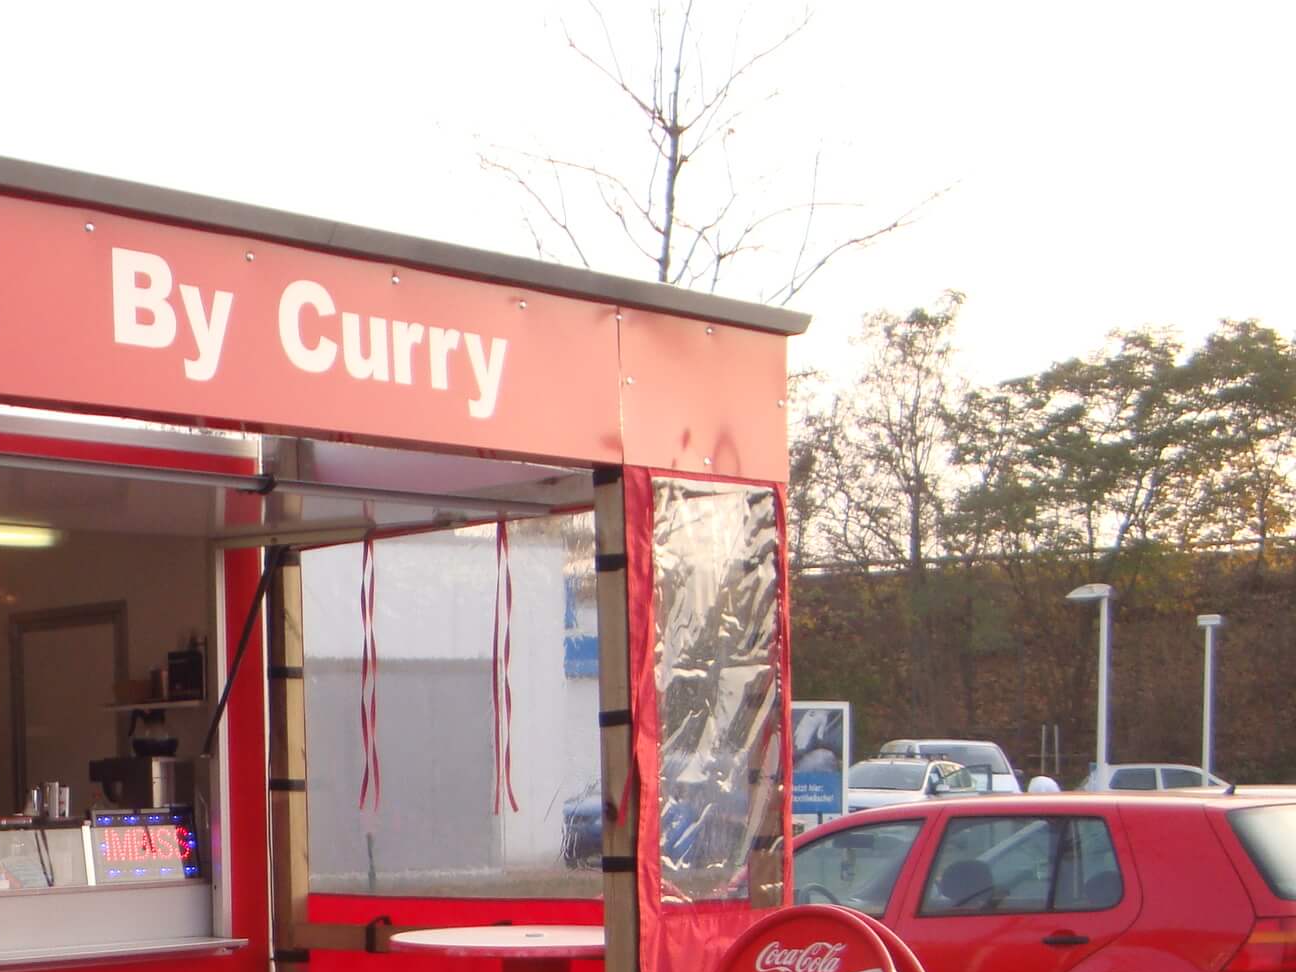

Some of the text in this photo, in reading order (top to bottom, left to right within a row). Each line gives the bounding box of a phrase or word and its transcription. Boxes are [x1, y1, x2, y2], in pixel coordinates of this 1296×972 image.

[111, 247, 508, 419] By Curry
[104, 825, 192, 861] IMBISS
